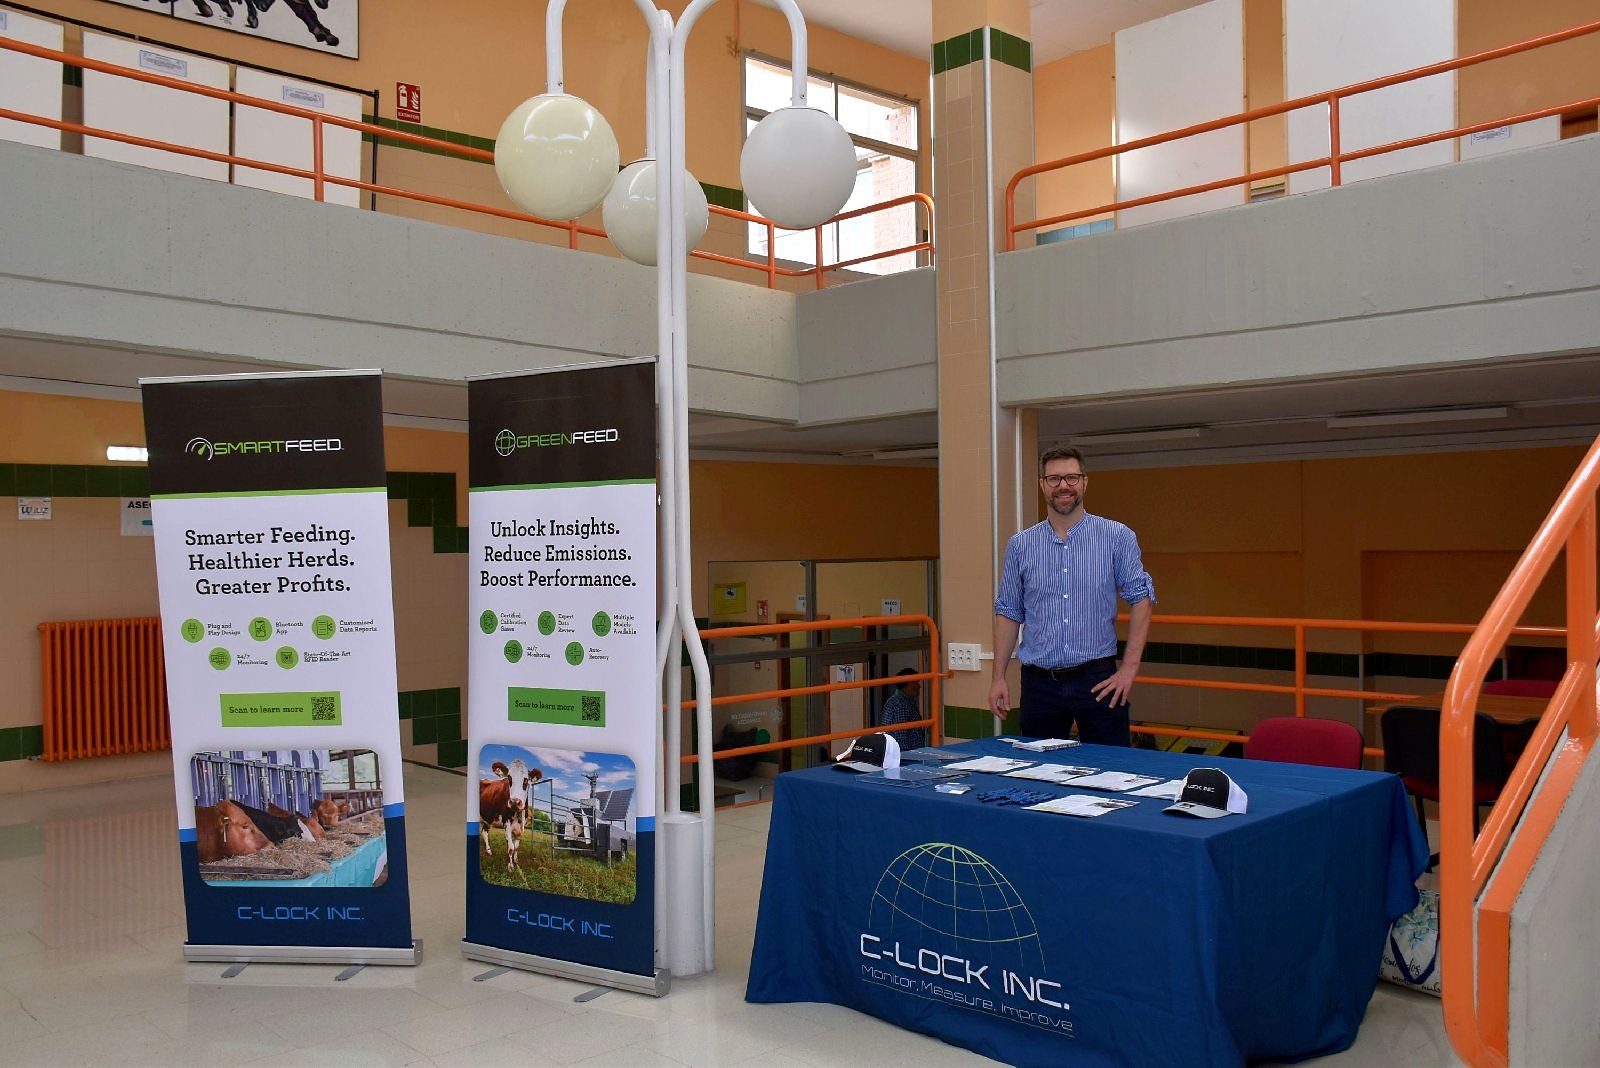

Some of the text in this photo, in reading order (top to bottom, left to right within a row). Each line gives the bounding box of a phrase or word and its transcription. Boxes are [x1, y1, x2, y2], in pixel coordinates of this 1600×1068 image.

[213, 438, 342, 455] SMARTFEED
[516, 428, 619, 449] GREENFEED
[185, 523, 356, 546] Smarter Feeding.
[490, 516, 620, 539] Unlock Insights.
[188, 548, 355, 570] Healthier Herds.
[484, 544, 632, 562] Reduce Emissions.
[196, 574, 351, 595] Greater Profits.
[480, 568, 636, 587] Boost Performance.
[354, 626, 378, 634] Reports
[229, 706, 249, 714] Scan
[260, 705, 281, 713] learn
[515, 700, 530, 708] Scan
[539, 701, 556, 710] learn
[237, 906, 365, 920] C-LOCK INC.
[506, 908, 614, 939] C-LOCK INC.
[859, 933, 1071, 1010] C-LOCK INC.
[1001, 1002, 1074, 1032] Improve
